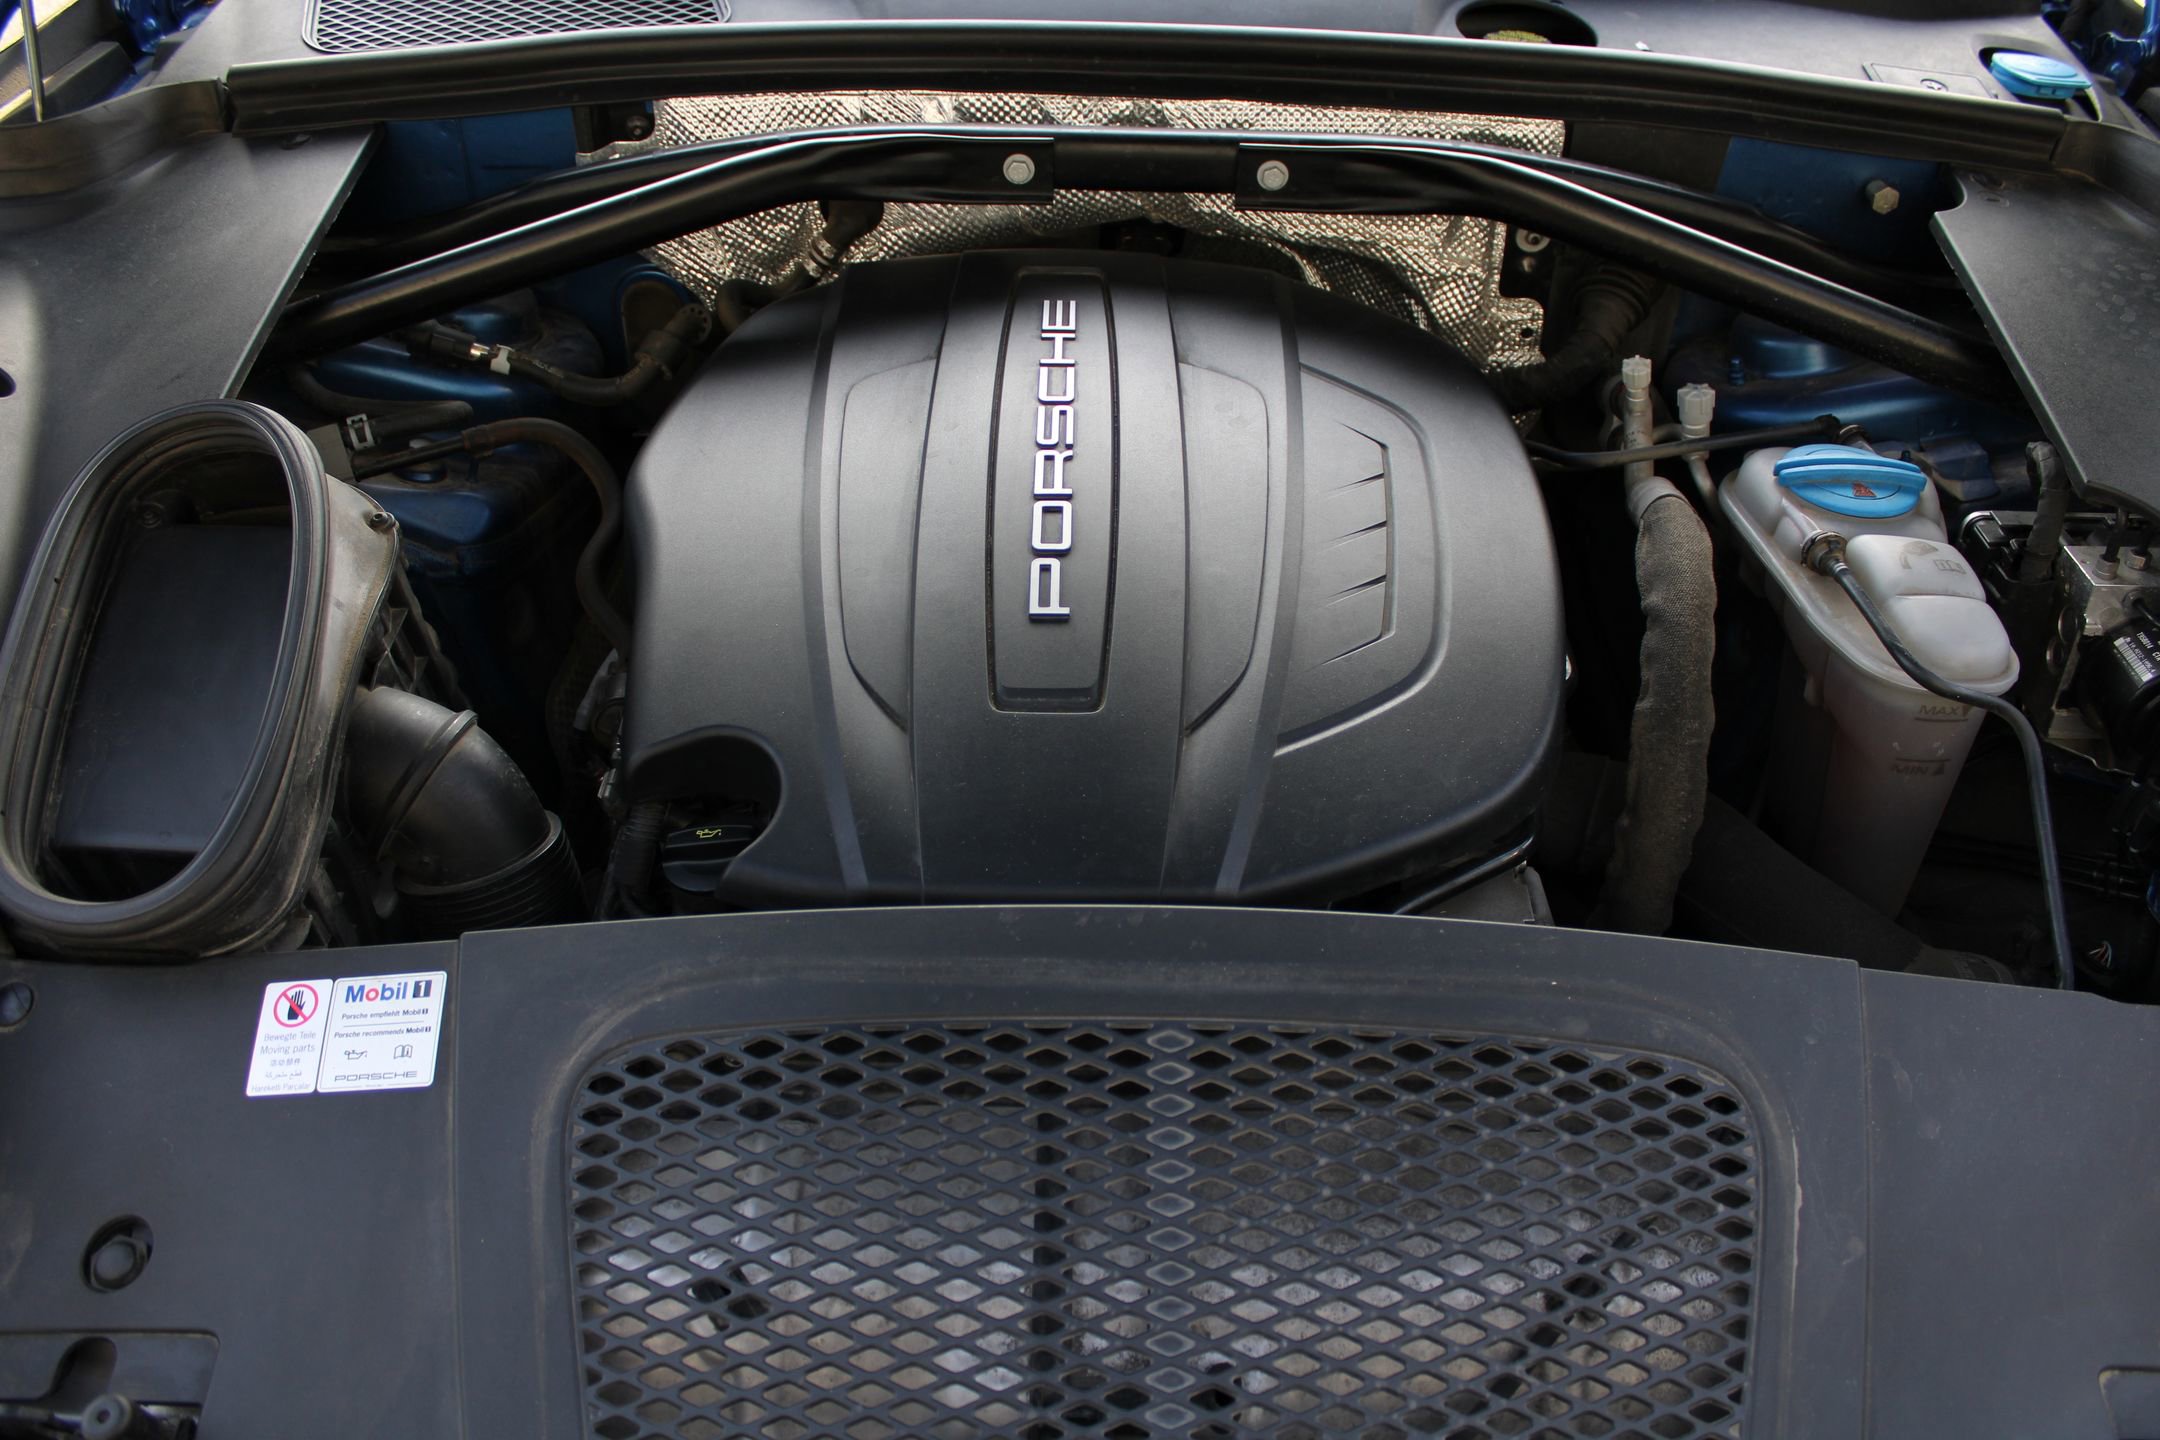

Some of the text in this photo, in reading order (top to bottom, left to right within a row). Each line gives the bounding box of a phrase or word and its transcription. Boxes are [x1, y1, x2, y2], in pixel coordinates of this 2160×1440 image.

[1028, 300, 1076, 622] PORSCHE
[1919, 704, 1958, 716] MAX
[1891, 763, 1929, 775] MIN
[345, 982, 408, 1003] Mobil
[342, 1012, 368, 1020] Porsche
[370, 1010, 400, 1018] empfiehlt
[402, 1008, 421, 1016] Mobil
[264, 1031, 316, 1042] Bewegte Teile
[362, 1028, 404, 1037] recommends
[260, 1043, 316, 1055] Moving parts
[334, 1071, 417, 1082] PORSCHE
